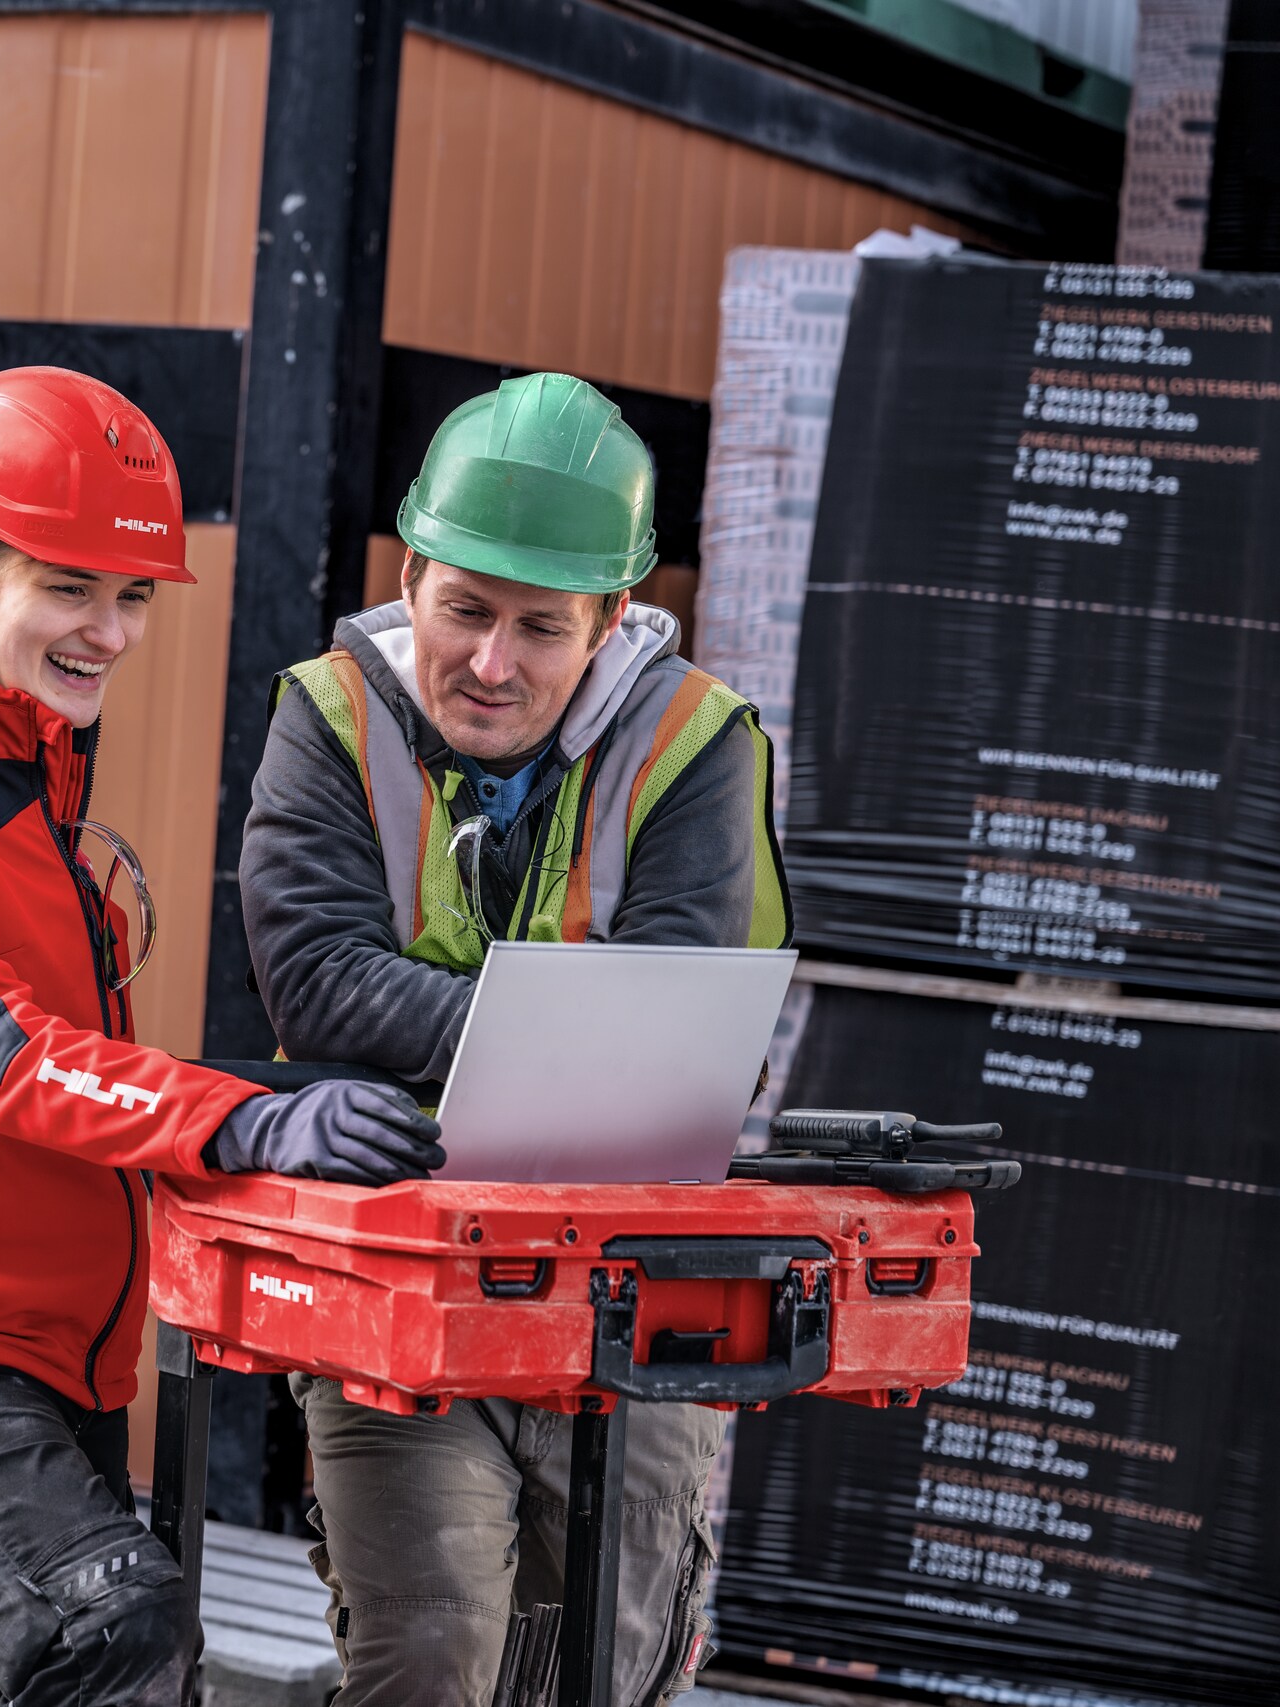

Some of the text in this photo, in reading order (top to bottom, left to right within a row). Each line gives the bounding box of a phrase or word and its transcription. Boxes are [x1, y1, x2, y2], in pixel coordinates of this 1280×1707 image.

[1154, 312, 1270, 332] GERSTHOFEN
[1141, 442, 1258, 463] DEISENDORF
[114, 517, 168, 535] HILTI
[1009, 502, 1126, 528] info@zwk.de
[1008, 522, 1120, 544] www.zwk.de
[980, 750, 1218, 789] WIR BRENNEN FÜR QUALITÄT
[1092, 808, 1166, 830] DACHAU
[986, 1050, 1092, 1080] info@zwk.de
[36, 1057, 163, 1114] HILTI
[984, 1070, 1086, 1096] www.zwk.de
[250, 1272, 313, 1306] HILTI
[978, 1304, 1180, 1348] BRENNEN FÜR QUALITÄT
[1052, 1364, 1128, 1390] DACHAU
[928, 1404, 1175, 1462] ZIEGELWERK GERSTHOFEN
[922, 1464, 1202, 1530] ZIEGELWERK KLOSTERBEUREN
[1032, 1545, 1150, 1578] DEISENDORF
[905, 1594, 1017, 1623] info@zwk.de
